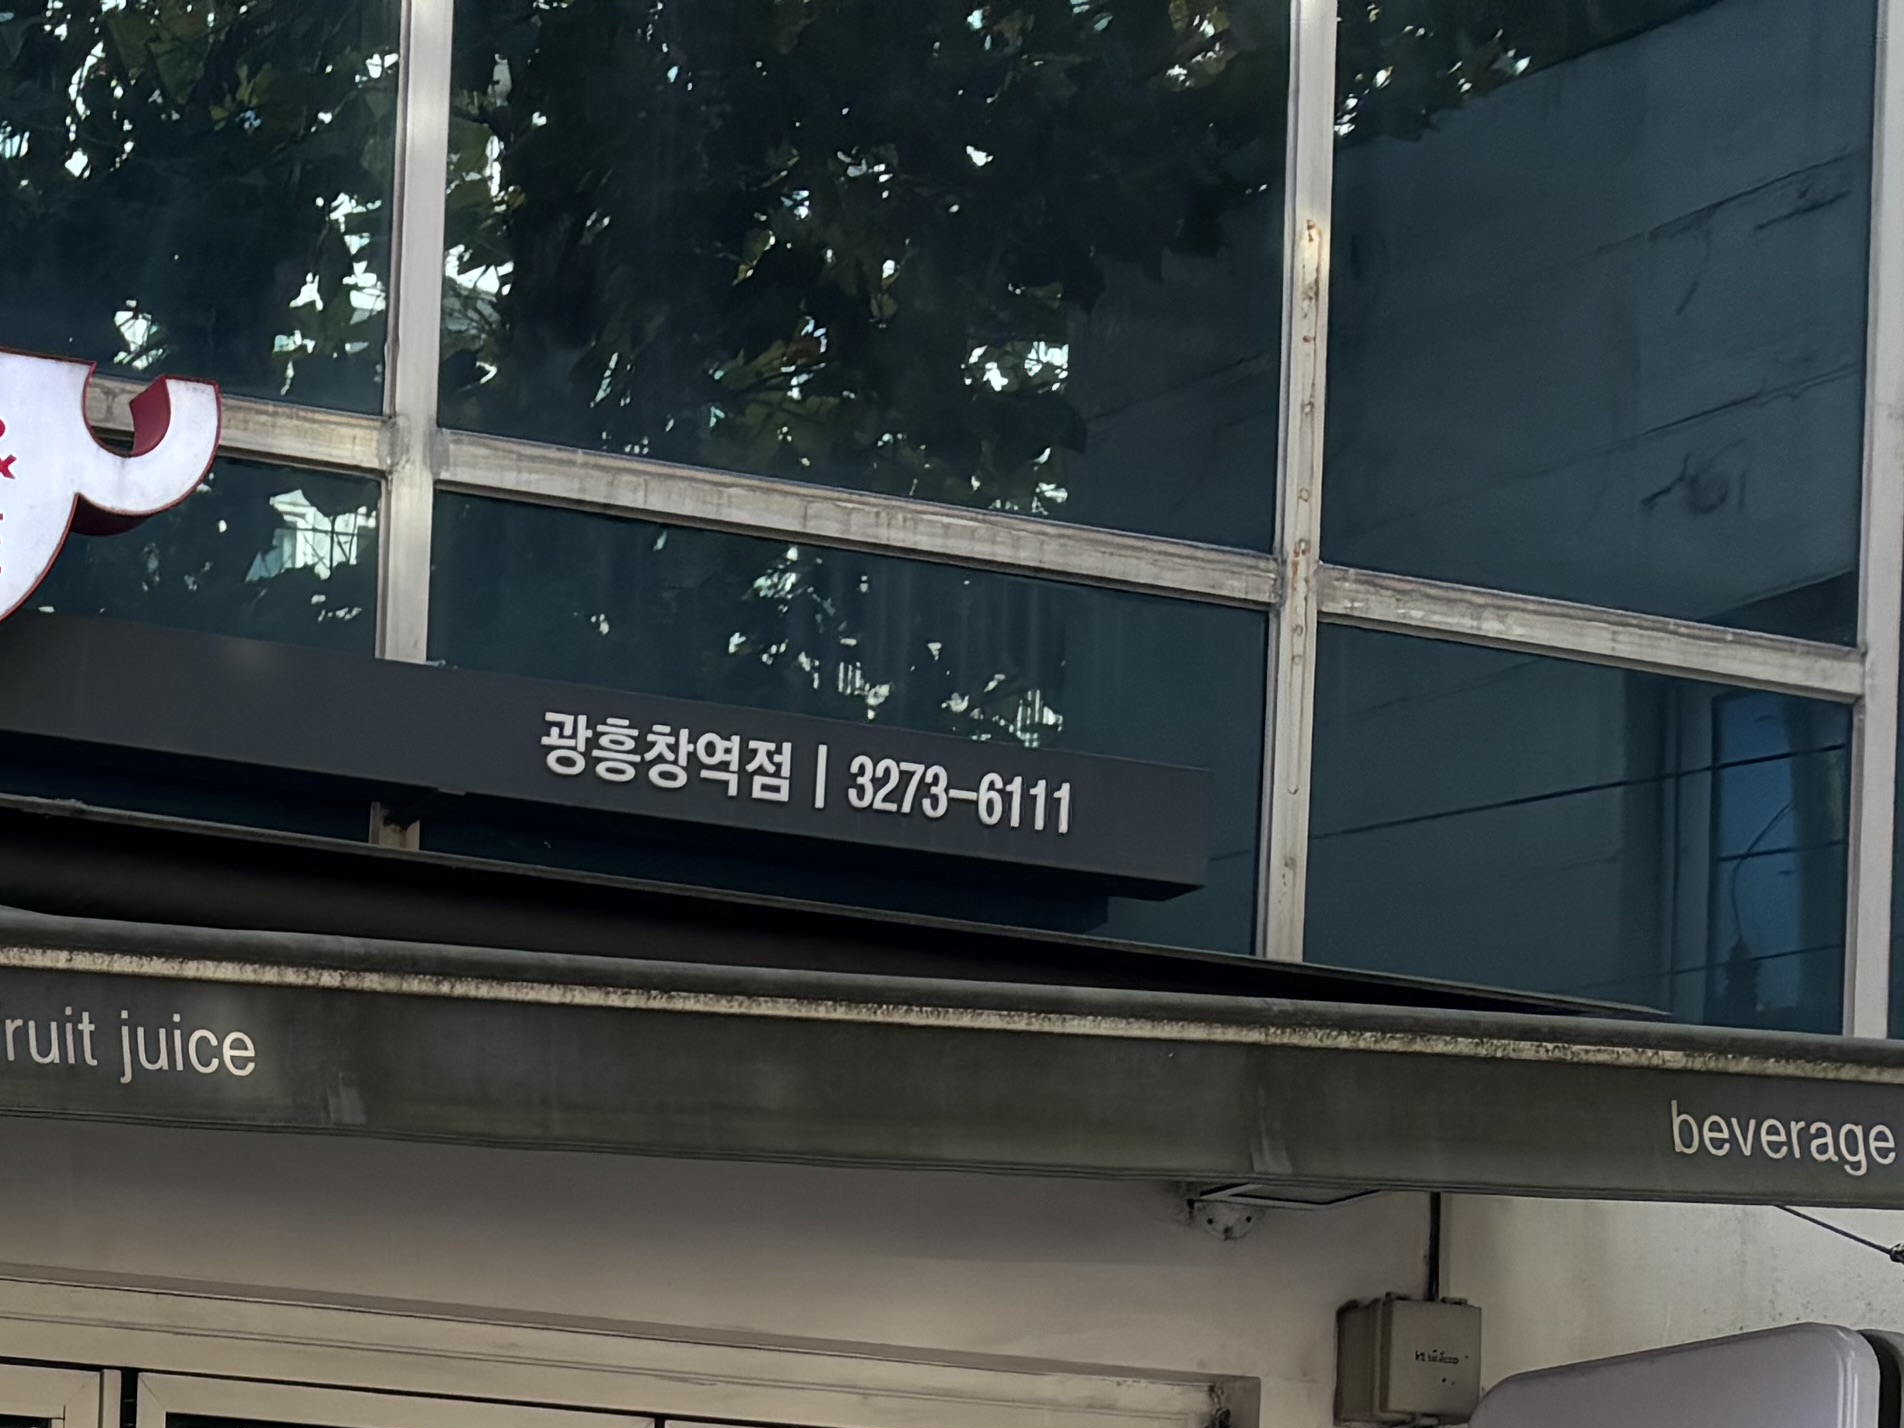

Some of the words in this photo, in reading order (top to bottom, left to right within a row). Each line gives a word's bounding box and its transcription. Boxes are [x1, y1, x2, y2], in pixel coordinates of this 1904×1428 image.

[541, 711, 791, 806] 광흥창역점
[847, 756, 1074, 836] 3273-6111
[120, 1010, 255, 1083] juice
[1670, 1100, 1897, 1178] beverage
